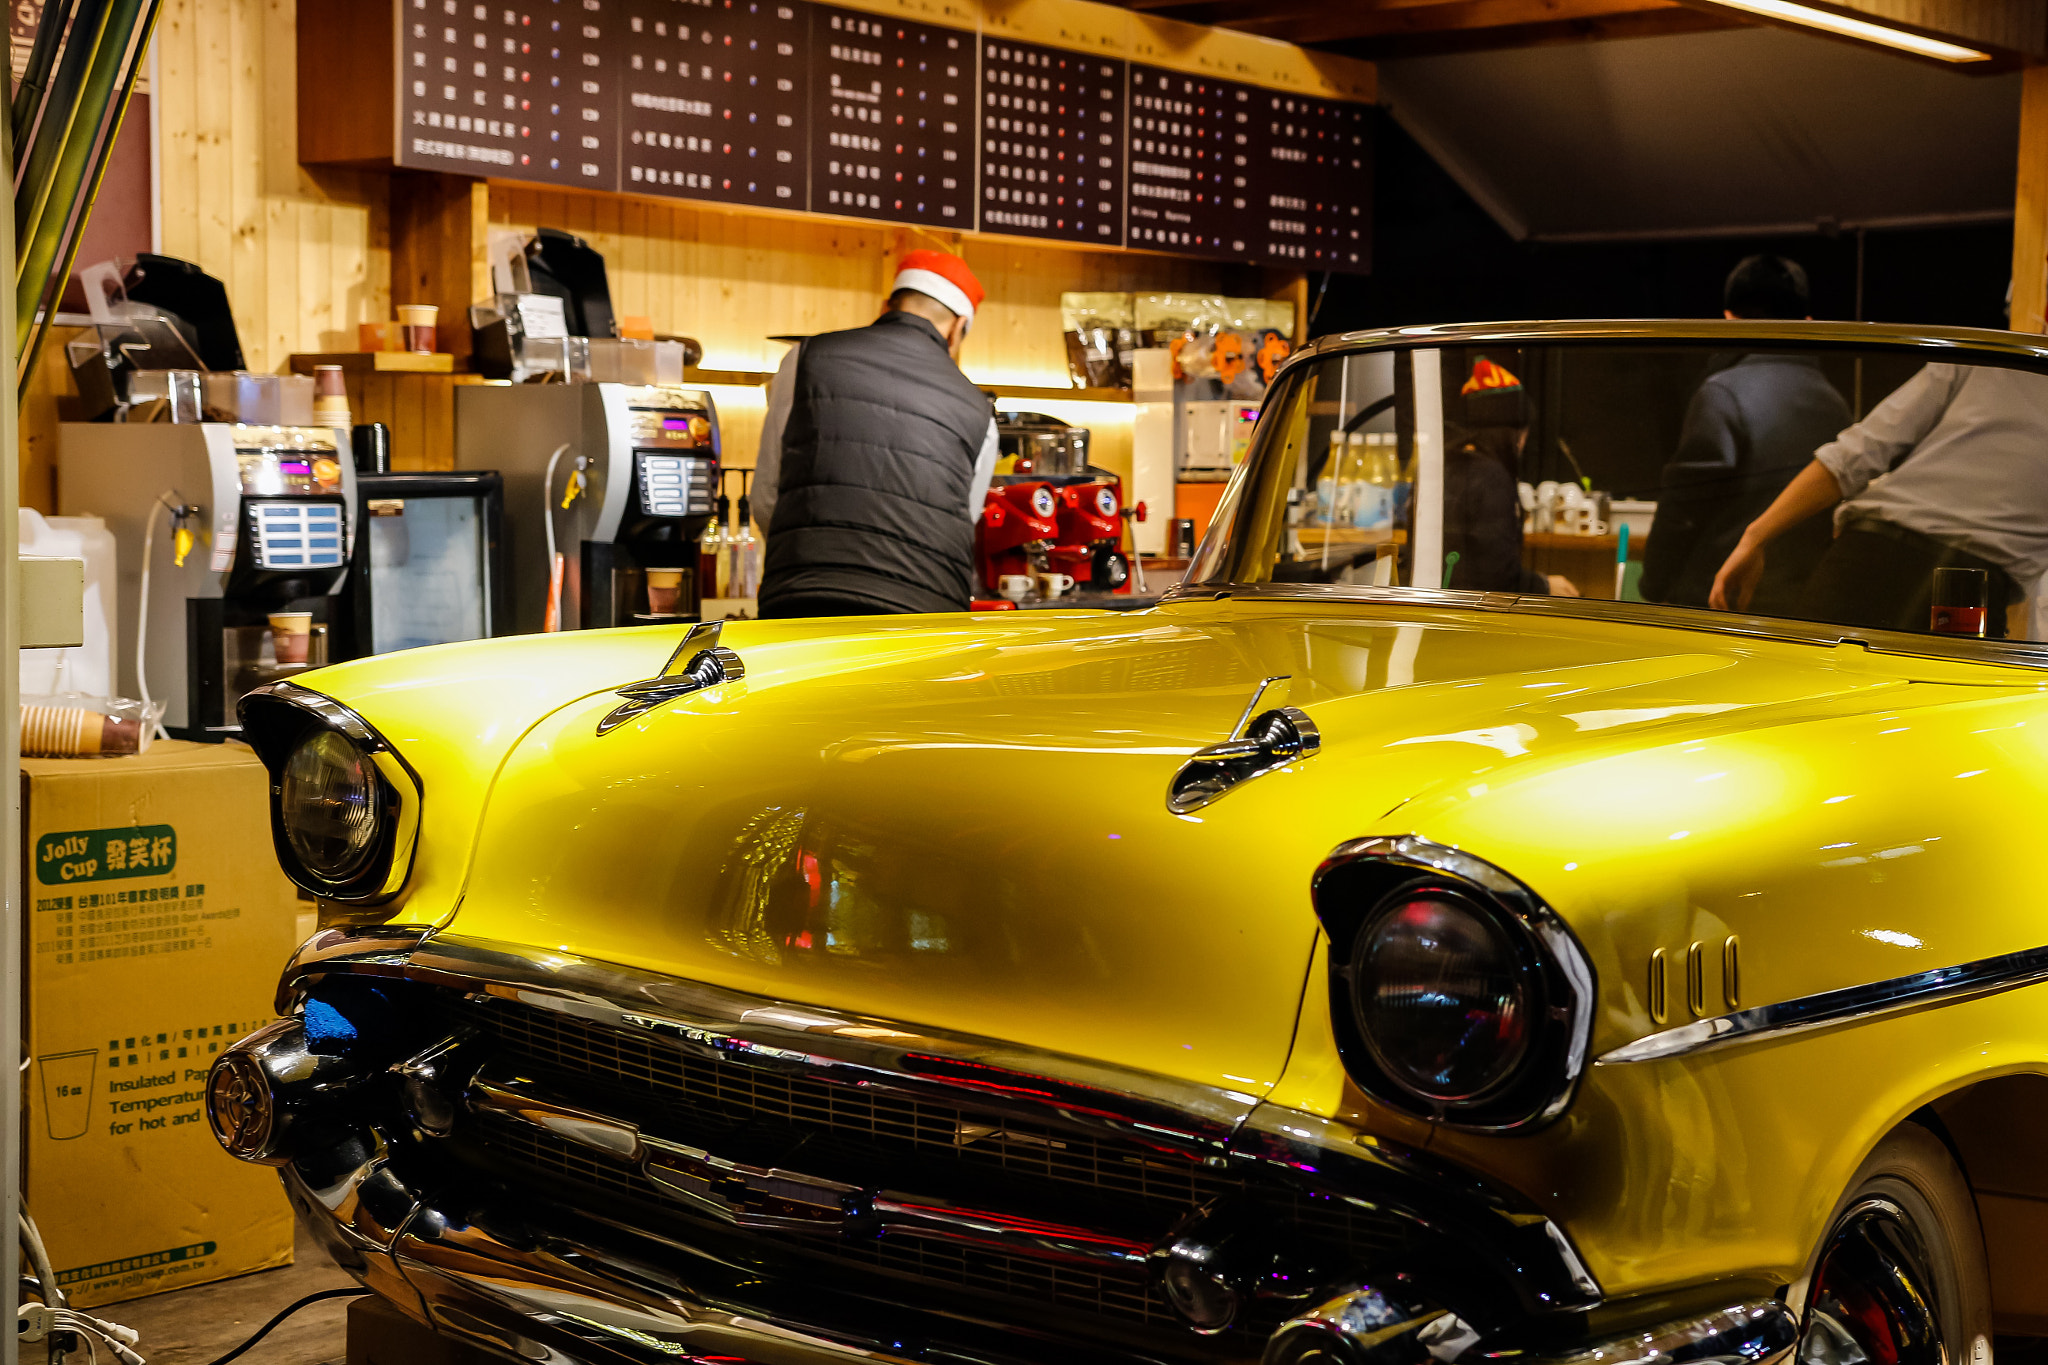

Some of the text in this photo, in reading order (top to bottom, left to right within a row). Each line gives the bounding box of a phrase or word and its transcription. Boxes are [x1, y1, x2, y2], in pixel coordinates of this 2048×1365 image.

[43, 836, 89, 863] Jolly
[106, 836, 172, 871] 發笑杯
[61, 859, 98, 880] Cup
[56, 1085, 69, 1098] 16
[109, 1068, 210, 1093] Insulated Pap
[109, 1090, 206, 1114] Temperatur
[109, 1108, 200, 1136] for hot and
